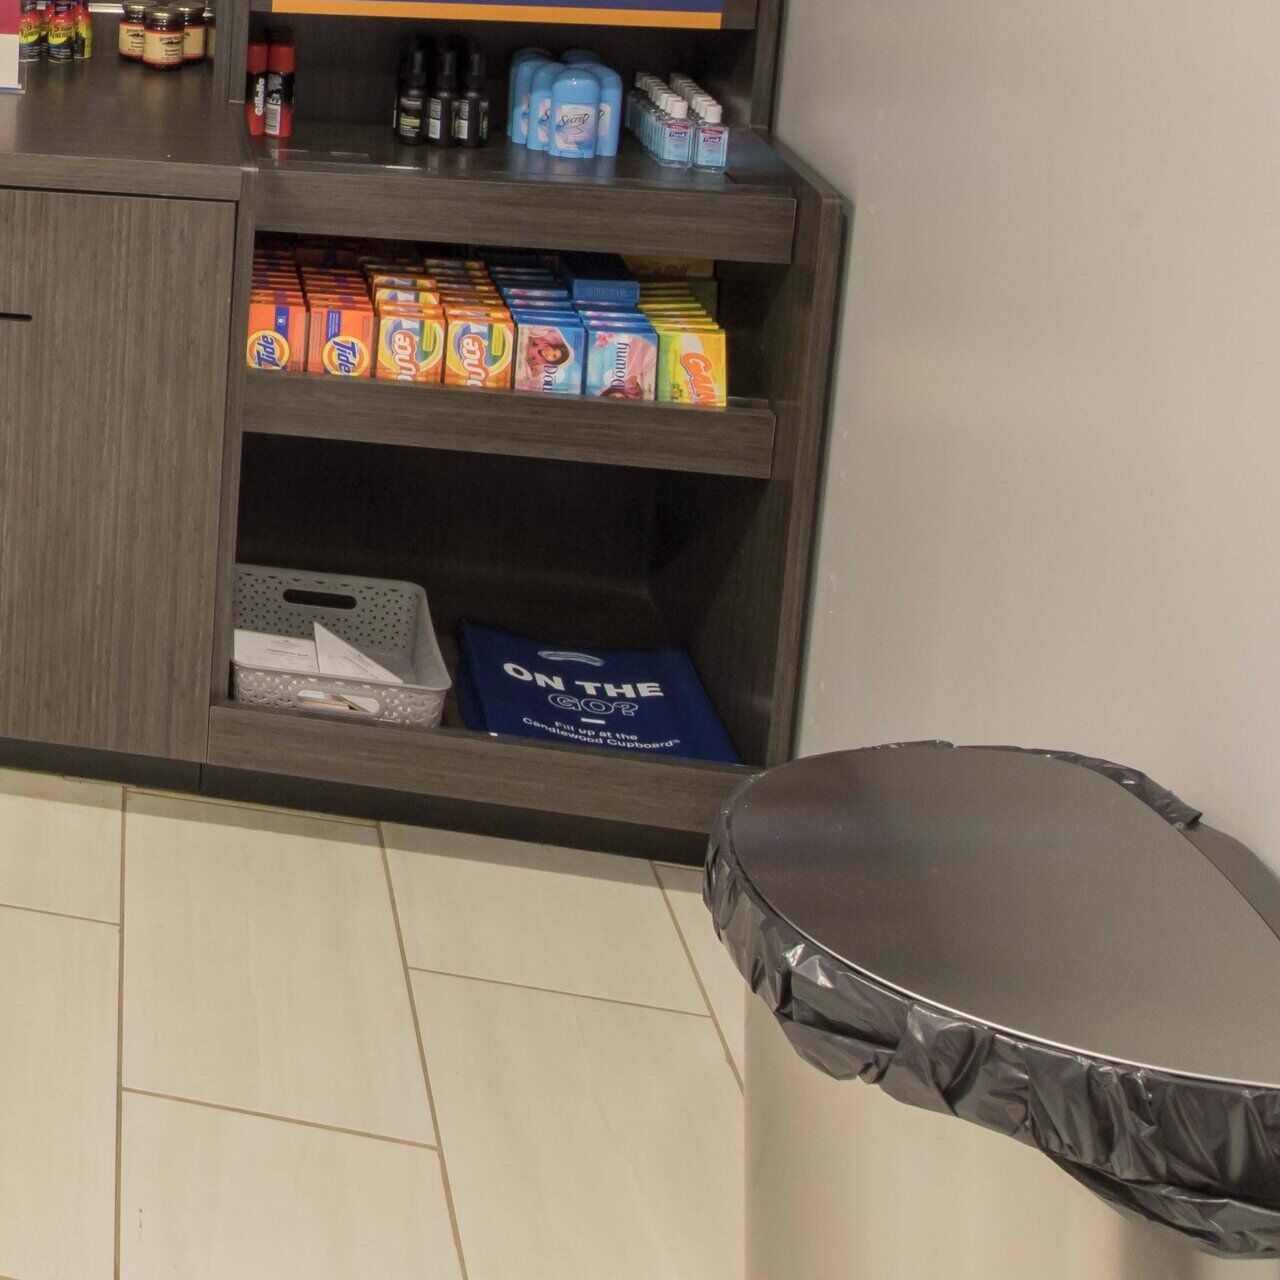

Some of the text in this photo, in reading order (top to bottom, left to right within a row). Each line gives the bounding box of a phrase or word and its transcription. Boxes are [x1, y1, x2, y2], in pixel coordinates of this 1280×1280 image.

[256, 334, 280, 368] Tide
[611, 342, 631, 390] Downy
[503, 663, 664, 698] ON THE
[523, 717, 603, 744] Candlewood
[555, 721, 638, 741] Fill up at the
